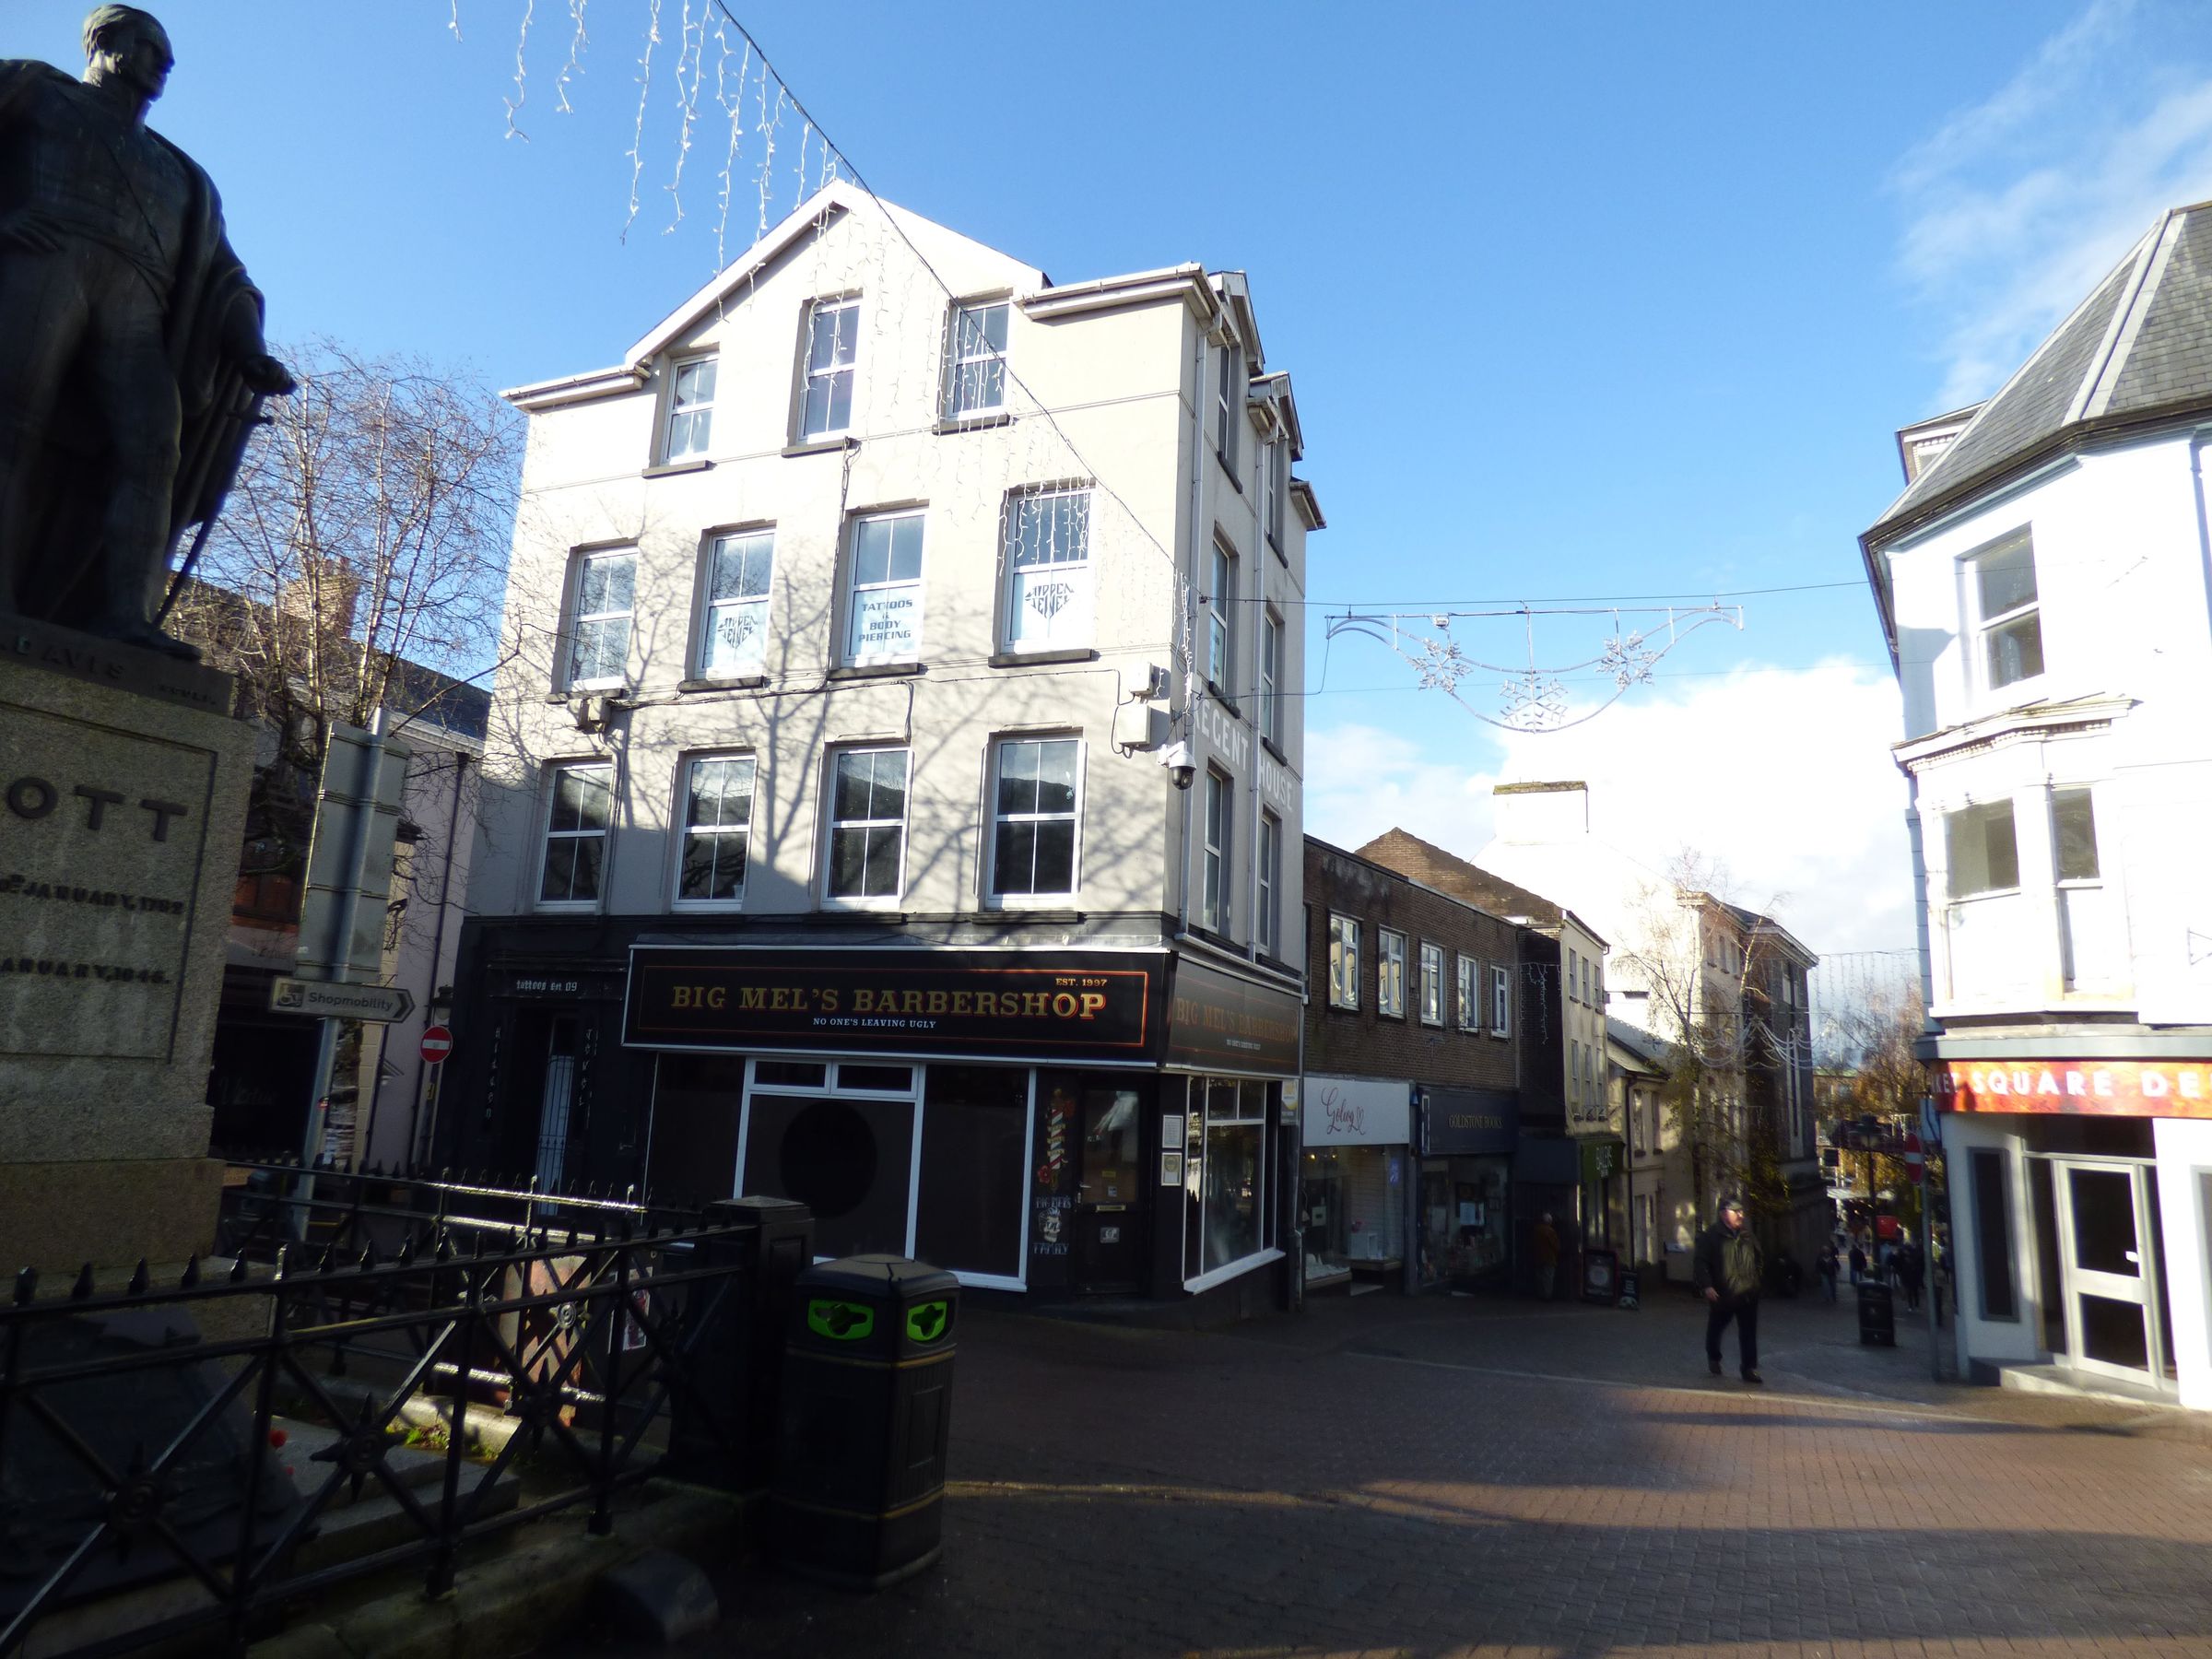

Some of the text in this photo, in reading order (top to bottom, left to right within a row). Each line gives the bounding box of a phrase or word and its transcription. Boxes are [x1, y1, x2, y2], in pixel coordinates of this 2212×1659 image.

[862, 599, 912, 612] TATTOOS
[869, 620, 901, 630] BODY
[858, 629, 912, 642] PIERCING
[1259, 752, 1292, 812] HOUSE
[565, 982, 578, 992] 09
[1055, 978, 1107, 987] EST. 1997
[309, 992, 394, 1013] Shopmobility
[671, 986, 1106, 1021] BIG MEL'S BARBERSHOP
[830, 1018, 858, 1026] ONE'S
[861, 1018, 905, 1028] LEAVING
[909, 1020, 936, 1029] UGLY
[1972, 1070, 2112, 1097] SQUARE
[2139, 1070, 2212, 1098] DE
